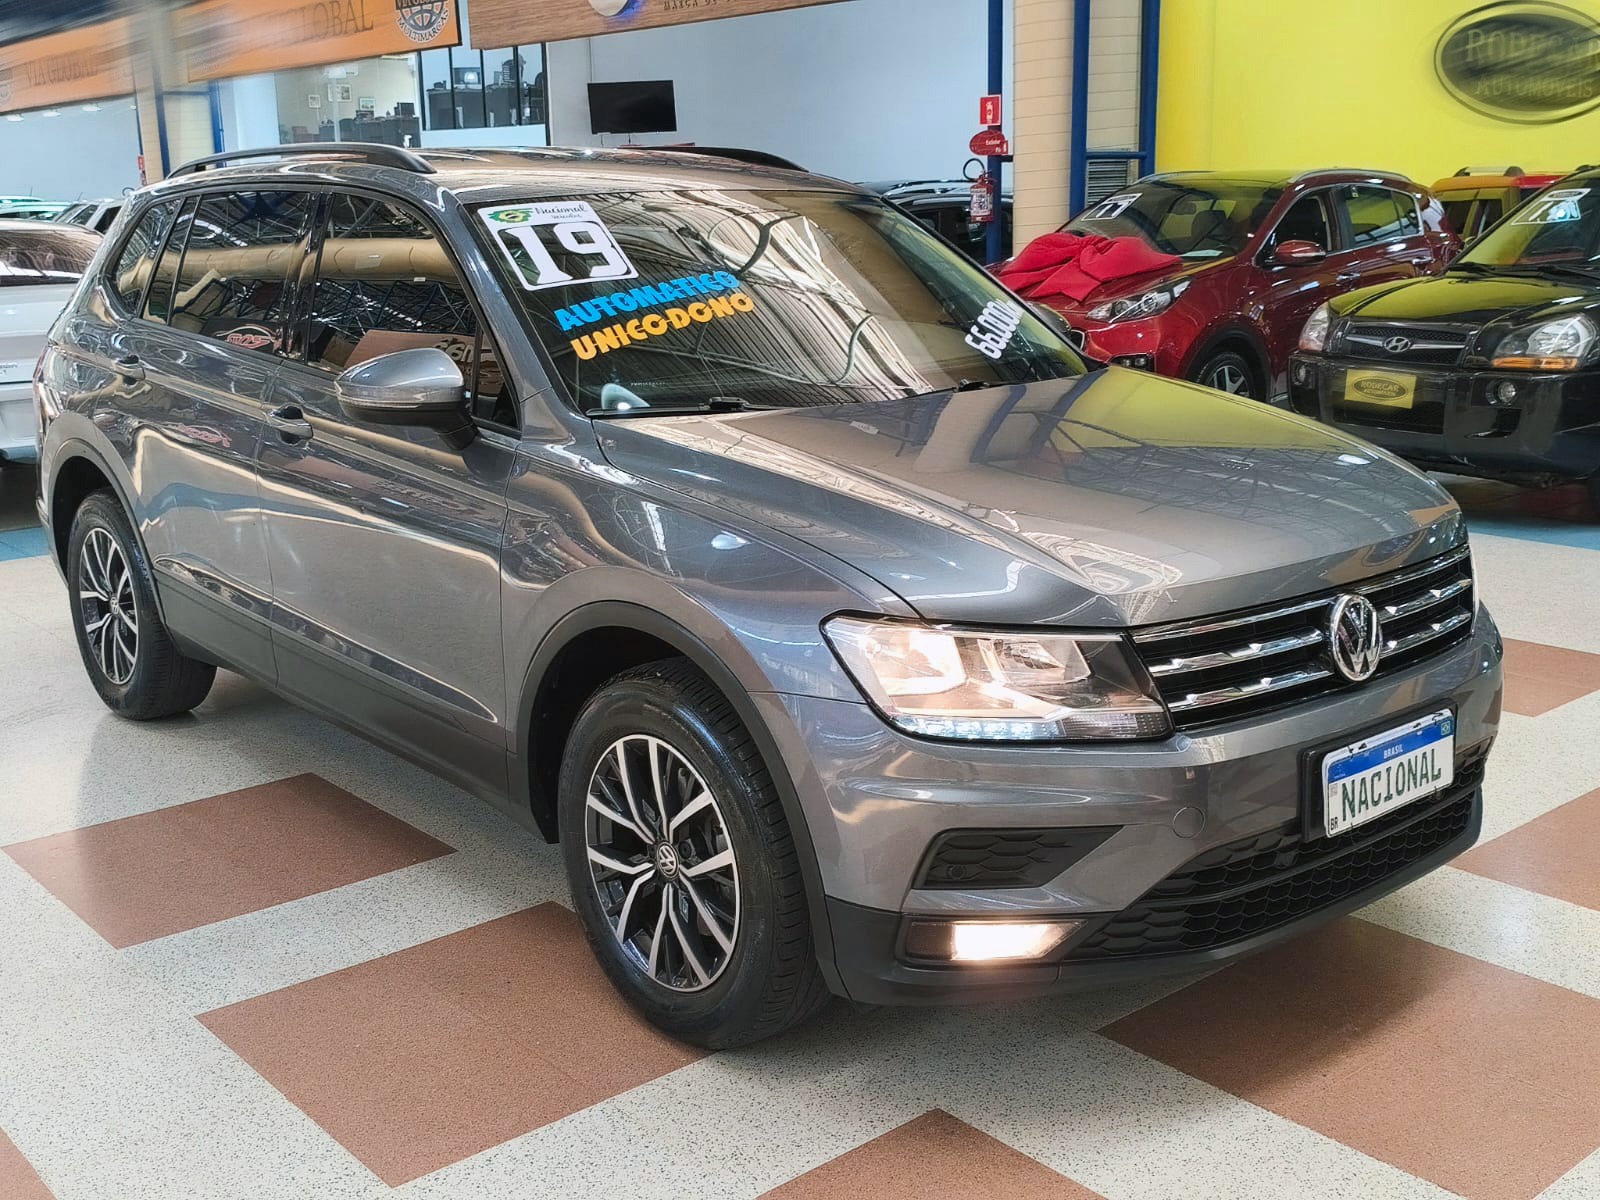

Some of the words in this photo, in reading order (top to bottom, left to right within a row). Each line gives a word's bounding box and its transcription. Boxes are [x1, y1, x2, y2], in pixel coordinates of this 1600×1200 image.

[502, 221, 629, 286] 19
[553, 270, 741, 332] AUTOMATICO
[1383, 744, 1403, 759] BRASIL
[1341, 748, 1442, 822] NACIONAL
[1330, 817, 1338, 831] BR
